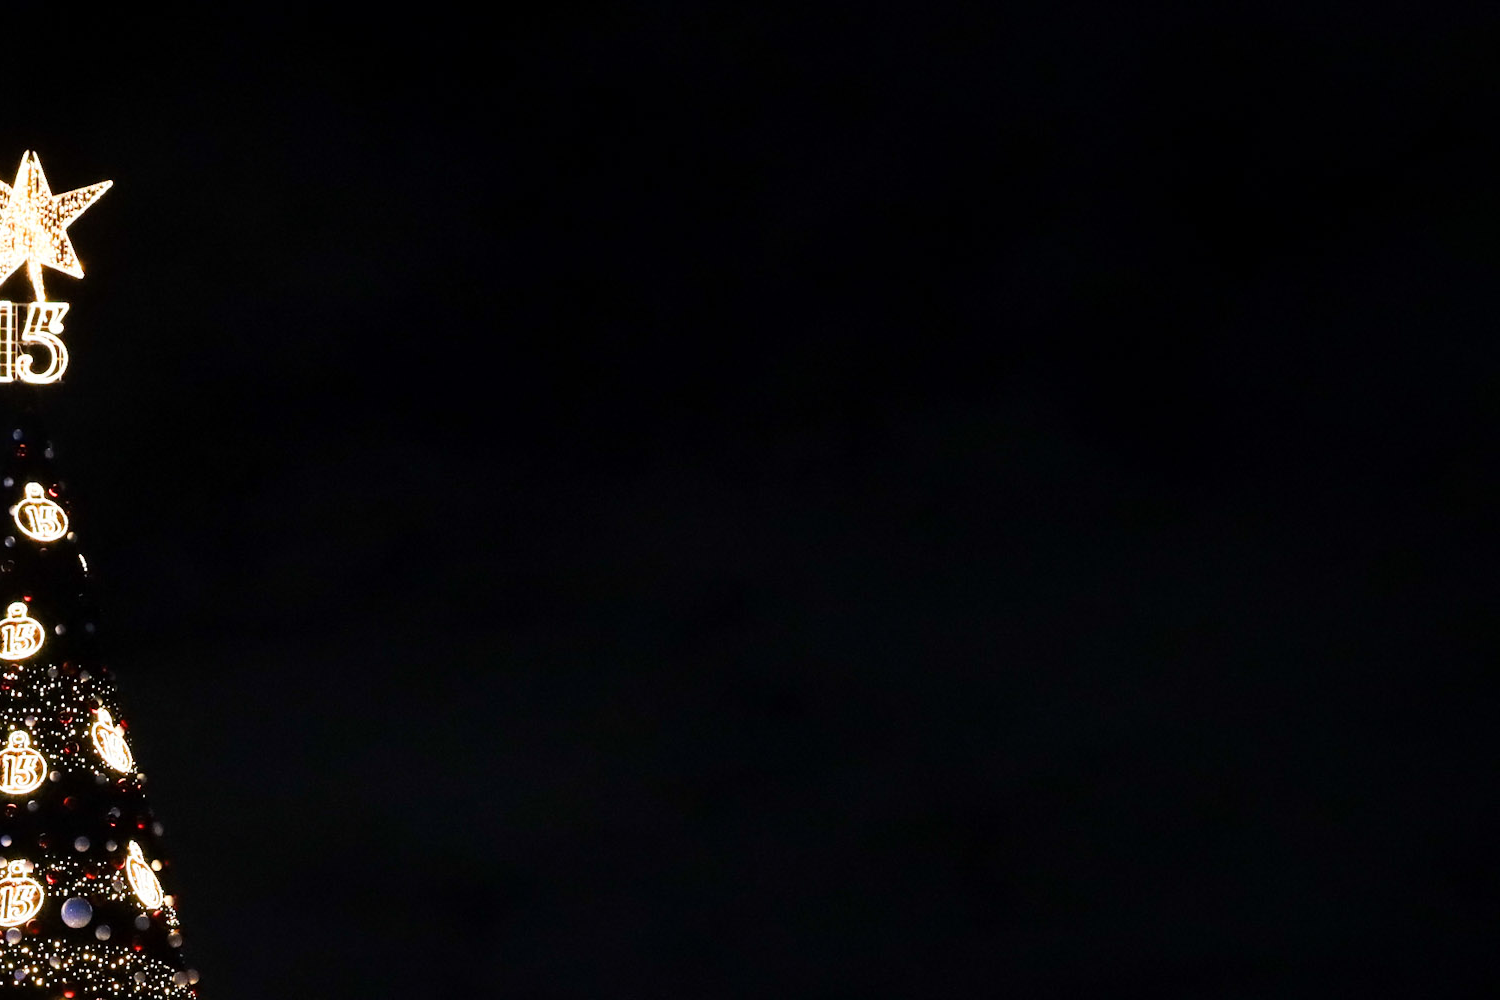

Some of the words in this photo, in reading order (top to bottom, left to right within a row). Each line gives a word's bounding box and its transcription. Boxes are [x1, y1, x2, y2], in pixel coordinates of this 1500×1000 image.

[25, 504, 62, 535] 15
[1, 624, 36, 654] 15
[2, 752, 39, 786] 15
[0, 883, 37, 920] 15
